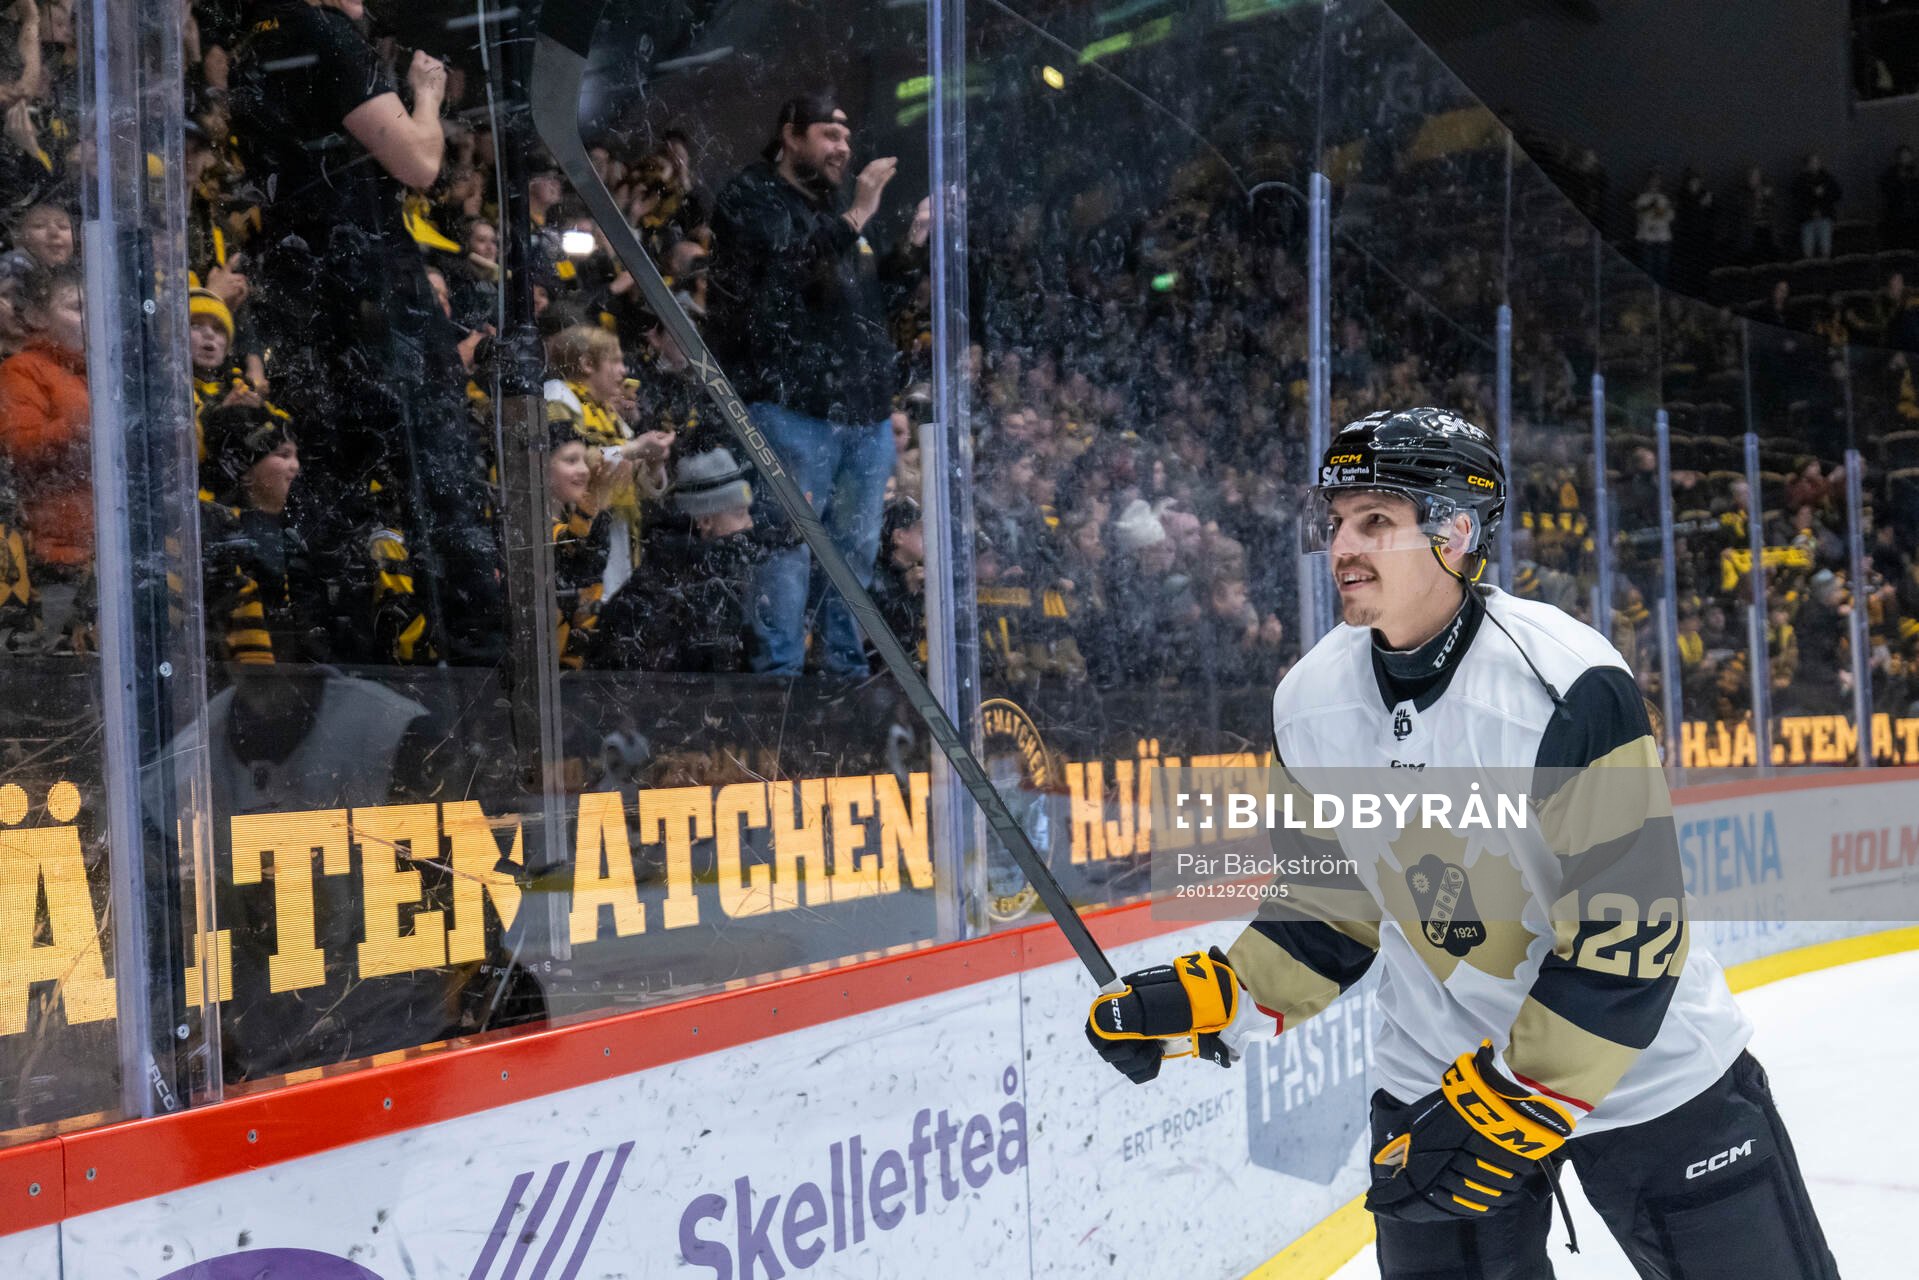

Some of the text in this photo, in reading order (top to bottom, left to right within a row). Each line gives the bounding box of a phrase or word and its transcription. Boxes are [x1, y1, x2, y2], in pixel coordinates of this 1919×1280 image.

[728, 400, 787, 479] GHOST
[1330, 454, 1362, 465] CCM
[1342, 467, 1369, 475] Skellefteå
[1467, 475, 1494, 489] CCM
[1433, 536, 1449, 544] CCM
[1433, 616, 1463, 669] CCM
[1679, 810, 1782, 897] STENA
[1453, 926, 1478, 939] 1921
[1111, 998, 1123, 1031] CCM
[1123, 1088, 1235, 1162] ERT PROJEKT
[679, 1065, 1028, 1280] Skellefteå
[1685, 1139, 1757, 1179] CCM
